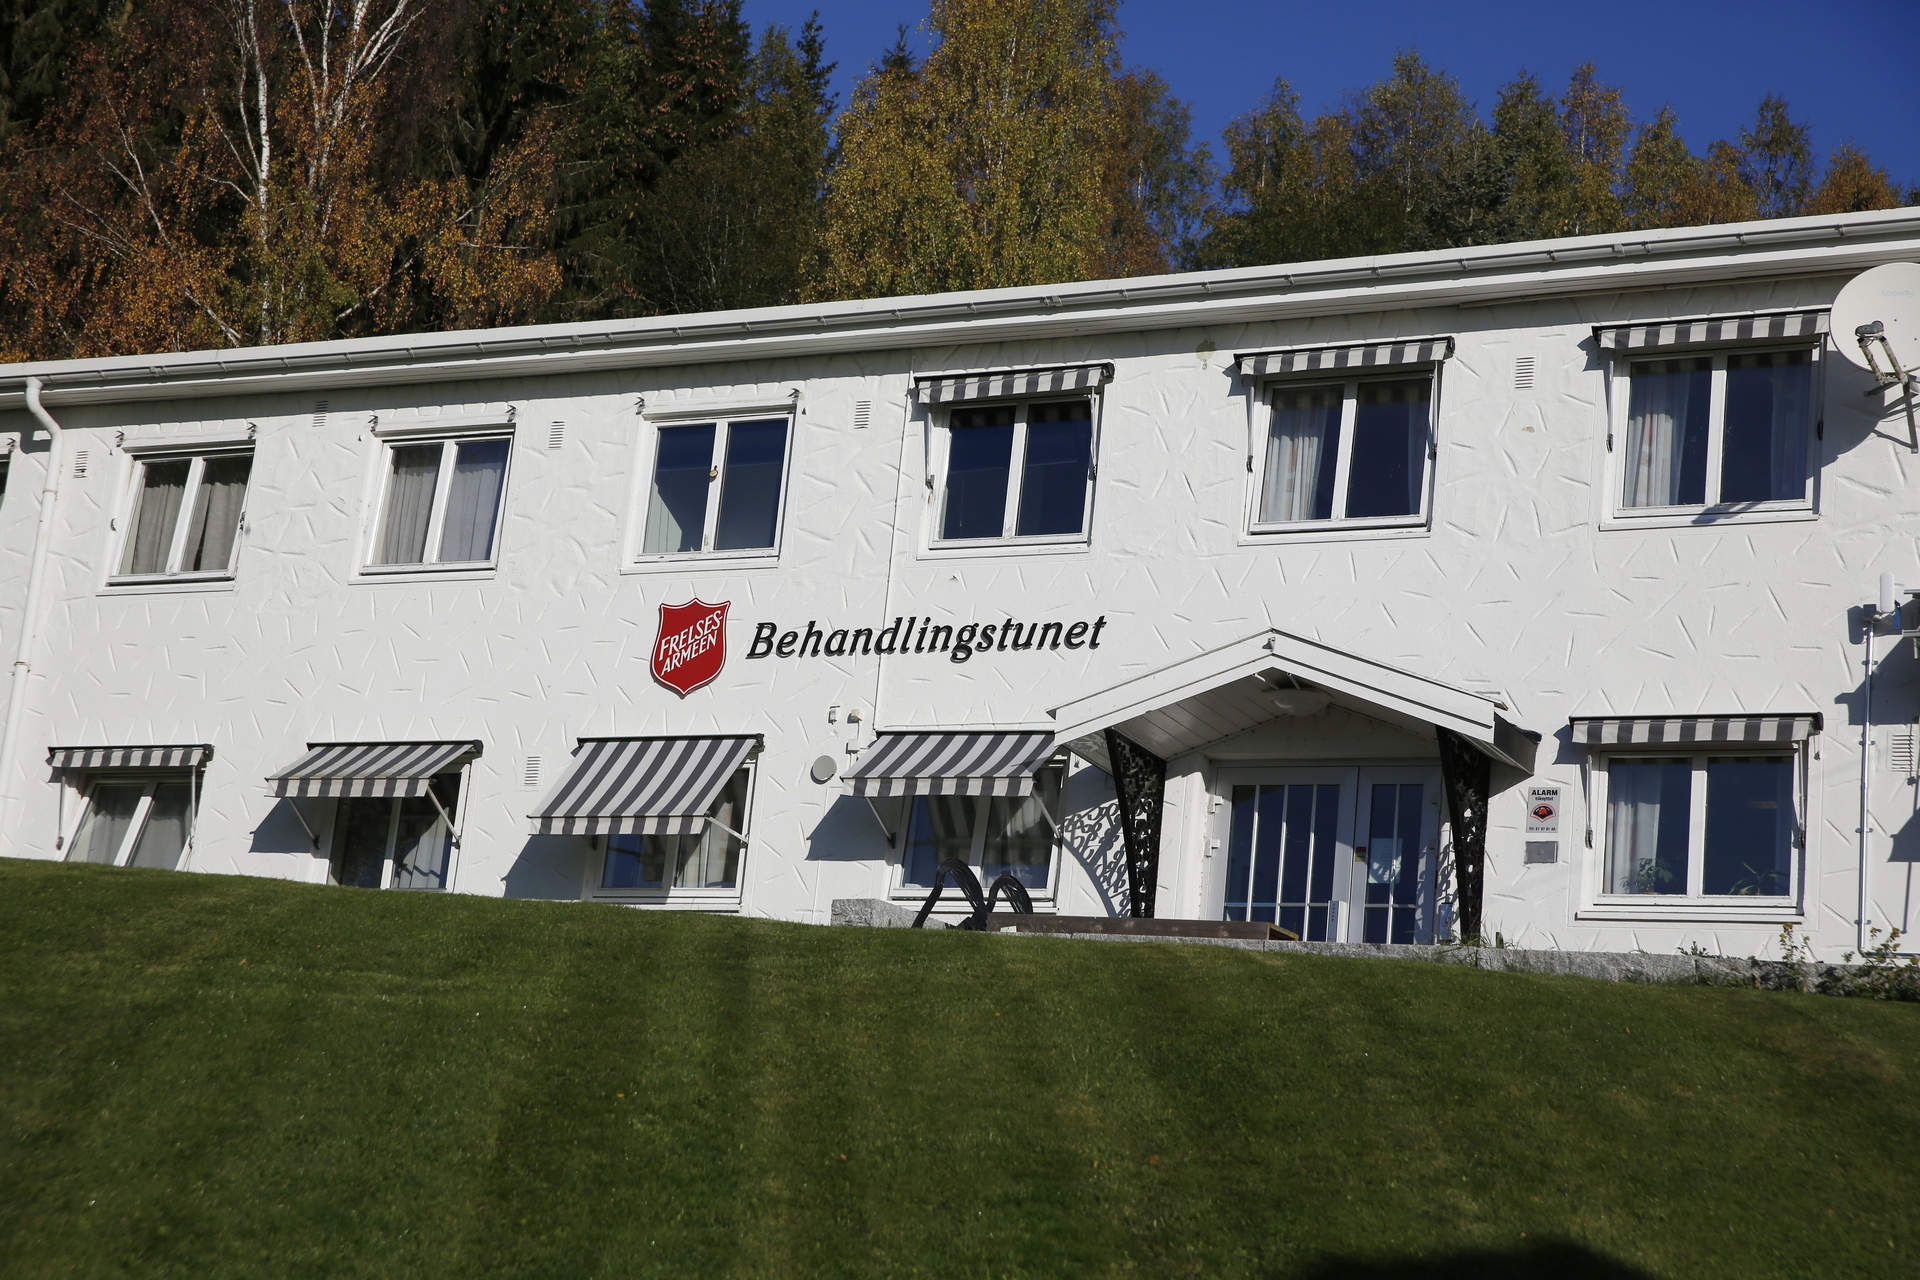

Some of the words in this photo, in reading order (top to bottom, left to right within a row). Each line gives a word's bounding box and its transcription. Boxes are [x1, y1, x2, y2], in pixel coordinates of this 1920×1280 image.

[1881, 289, 1914, 299] tooway
[659, 610, 723, 661] FRELSES
[661, 629, 717, 676] ARMEEN
[746, 616, 1107, 664] Behandlingstunet
